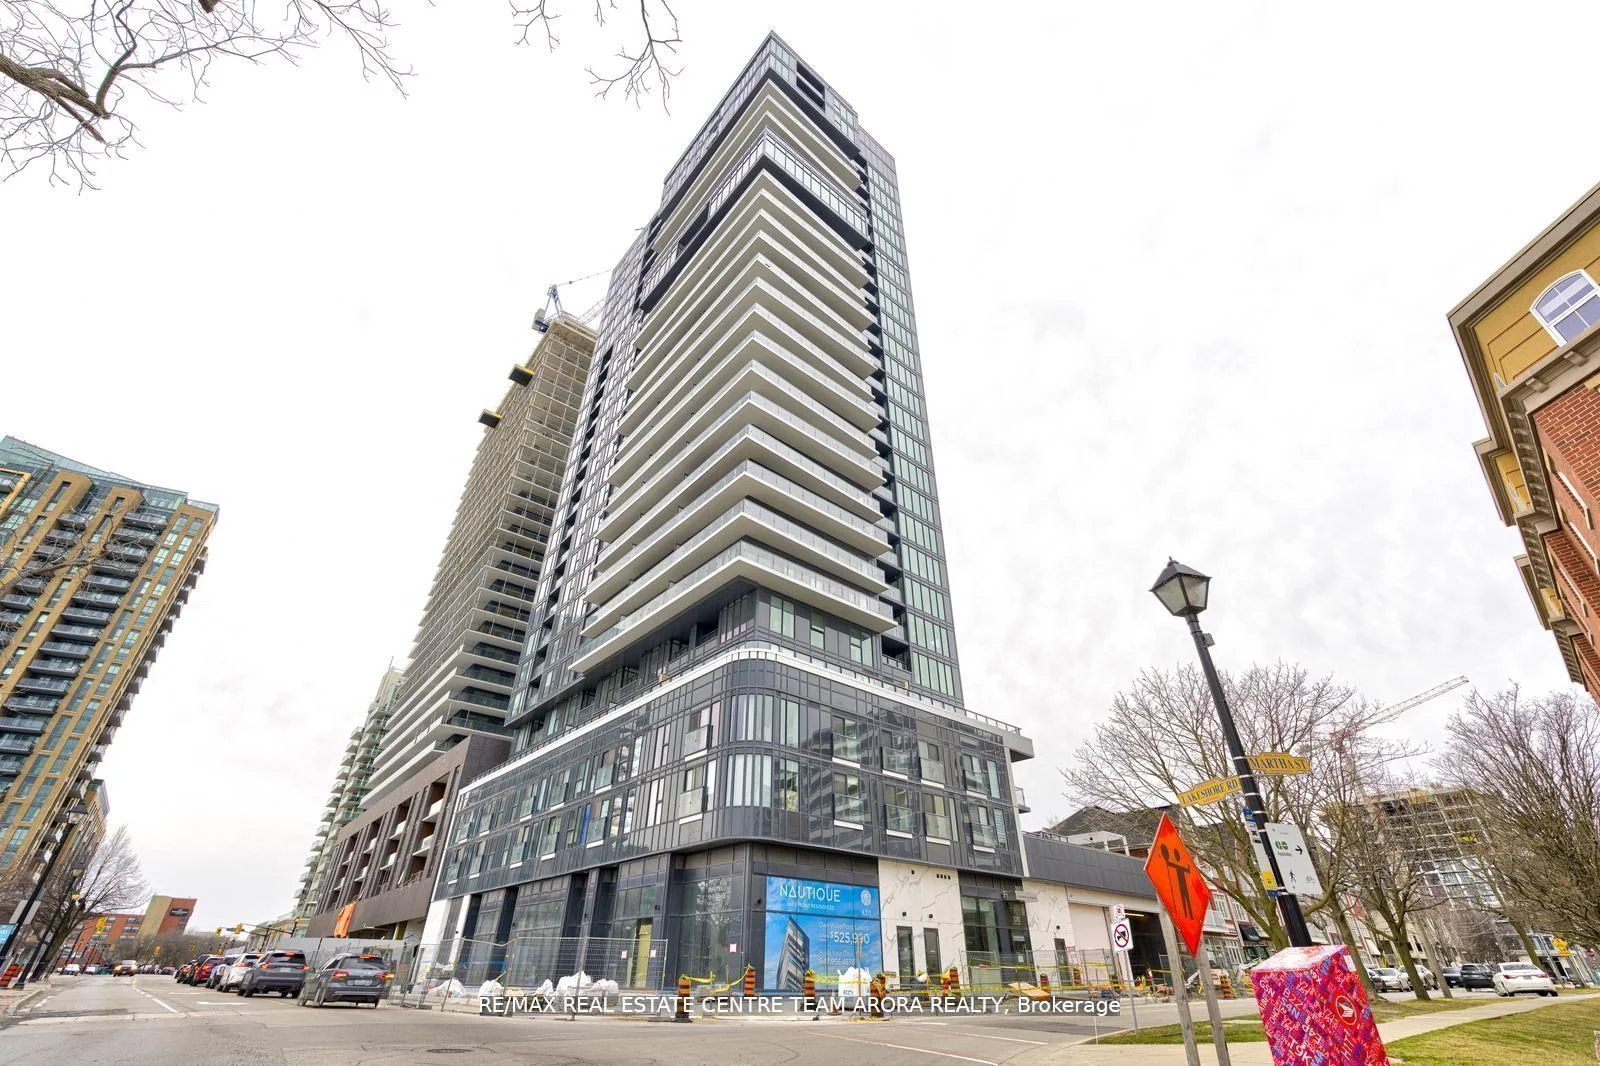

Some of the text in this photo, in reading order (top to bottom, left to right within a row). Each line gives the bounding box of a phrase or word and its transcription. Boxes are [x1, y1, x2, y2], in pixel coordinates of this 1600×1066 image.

[1249, 757, 1308, 770] MARTHA ST
[1180, 779, 1239, 805] LAKESHORE RD
[780, 885, 840, 902] NAUTIQUE
